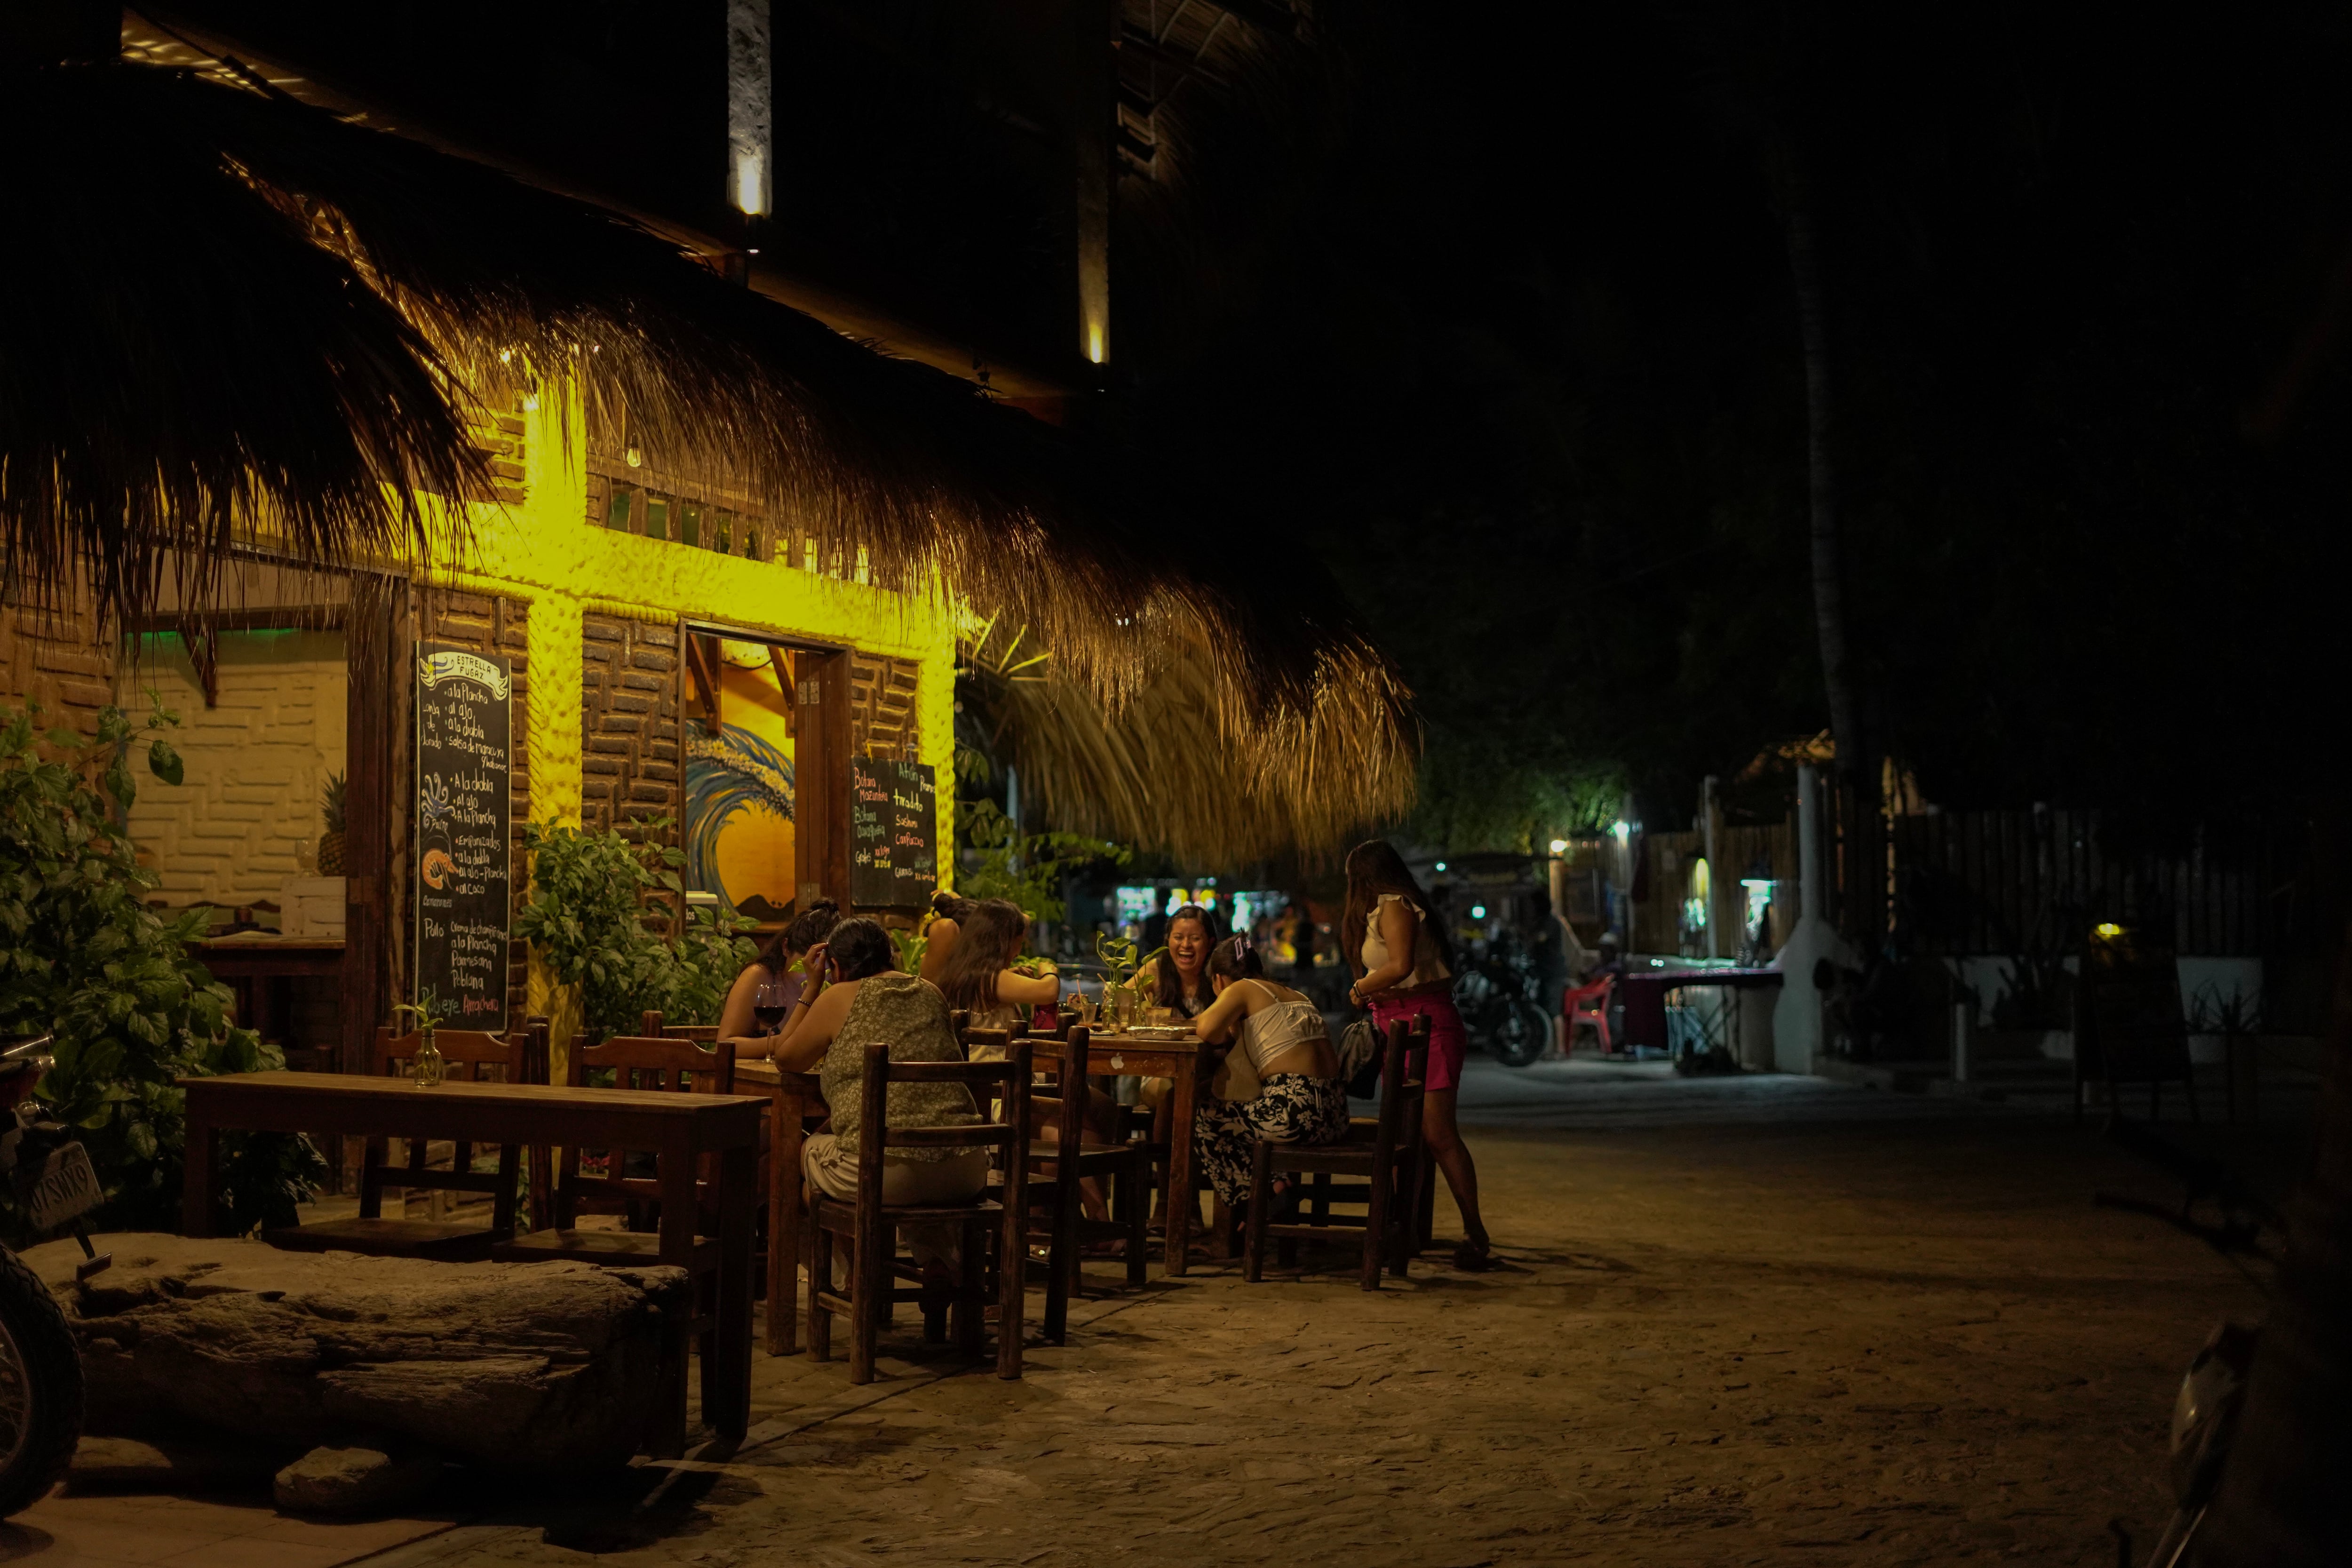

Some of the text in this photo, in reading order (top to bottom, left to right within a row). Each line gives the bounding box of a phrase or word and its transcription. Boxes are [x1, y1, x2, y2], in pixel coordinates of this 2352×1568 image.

[457, 656, 491, 674] ESTRELLA
[460, 667, 484, 680] FUGAZ
[447, 683, 488, 704] a la Plancha
[448, 701, 455, 714] al
[454, 717, 461, 732] la
[463, 716, 484, 740] diabla
[468, 738, 475, 753] de
[455, 768, 493, 794] A la diabla
[457, 793, 464, 806] Al
[457, 810, 462, 822] A
[464, 809, 470, 823] la
[464, 850, 471, 864] la
[451, 934, 497, 956] a la Plancha
